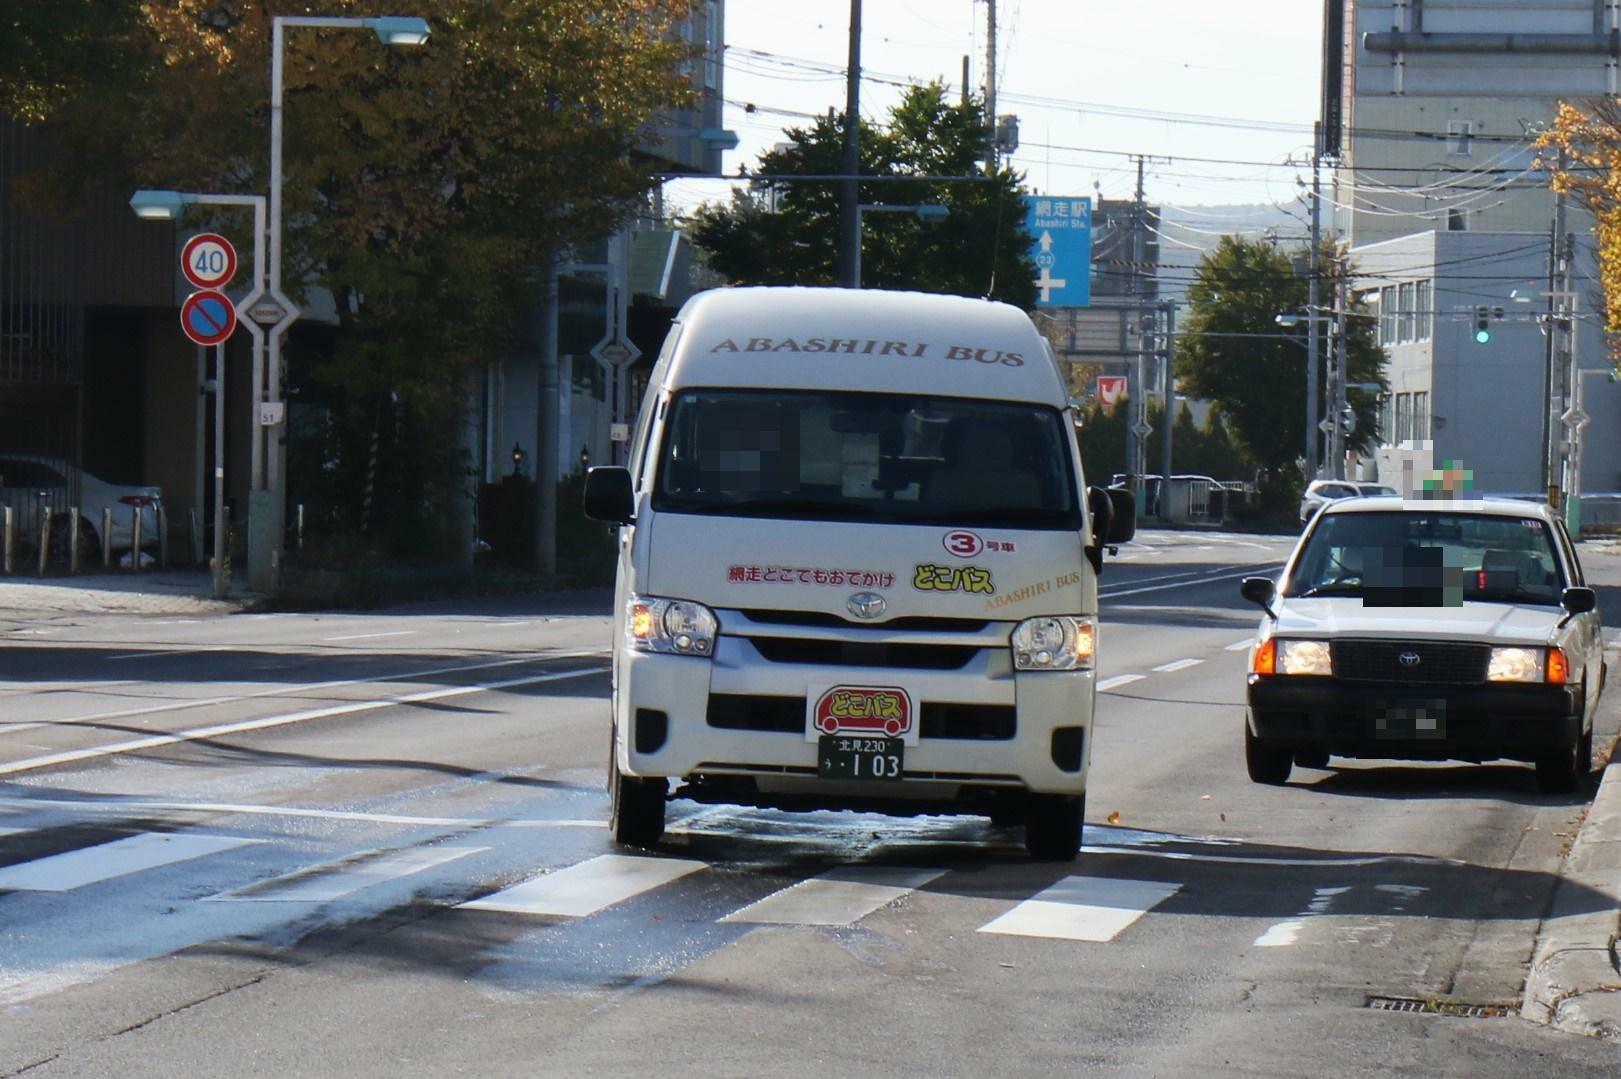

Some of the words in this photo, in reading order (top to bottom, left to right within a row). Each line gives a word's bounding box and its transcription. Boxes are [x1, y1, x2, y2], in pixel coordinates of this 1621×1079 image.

[1035, 201, 1088, 217] 網走駅
[1034, 218, 1068, 228] Abashiri
[1071, 218, 1087, 228] Sta.
[195, 250, 224, 273] 40
[710, 337, 929, 358] ABASHIRI
[945, 345, 1025, 368] BUS
[950, 534, 975, 553] 3
[985, 541, 1016, 553] 号車
[913, 564, 995, 594] どこバス
[984, 580, 1052, 611] ABASHIRI
[1055, 571, 1081, 588] BUS
[831, 692, 902, 719] どこバス
